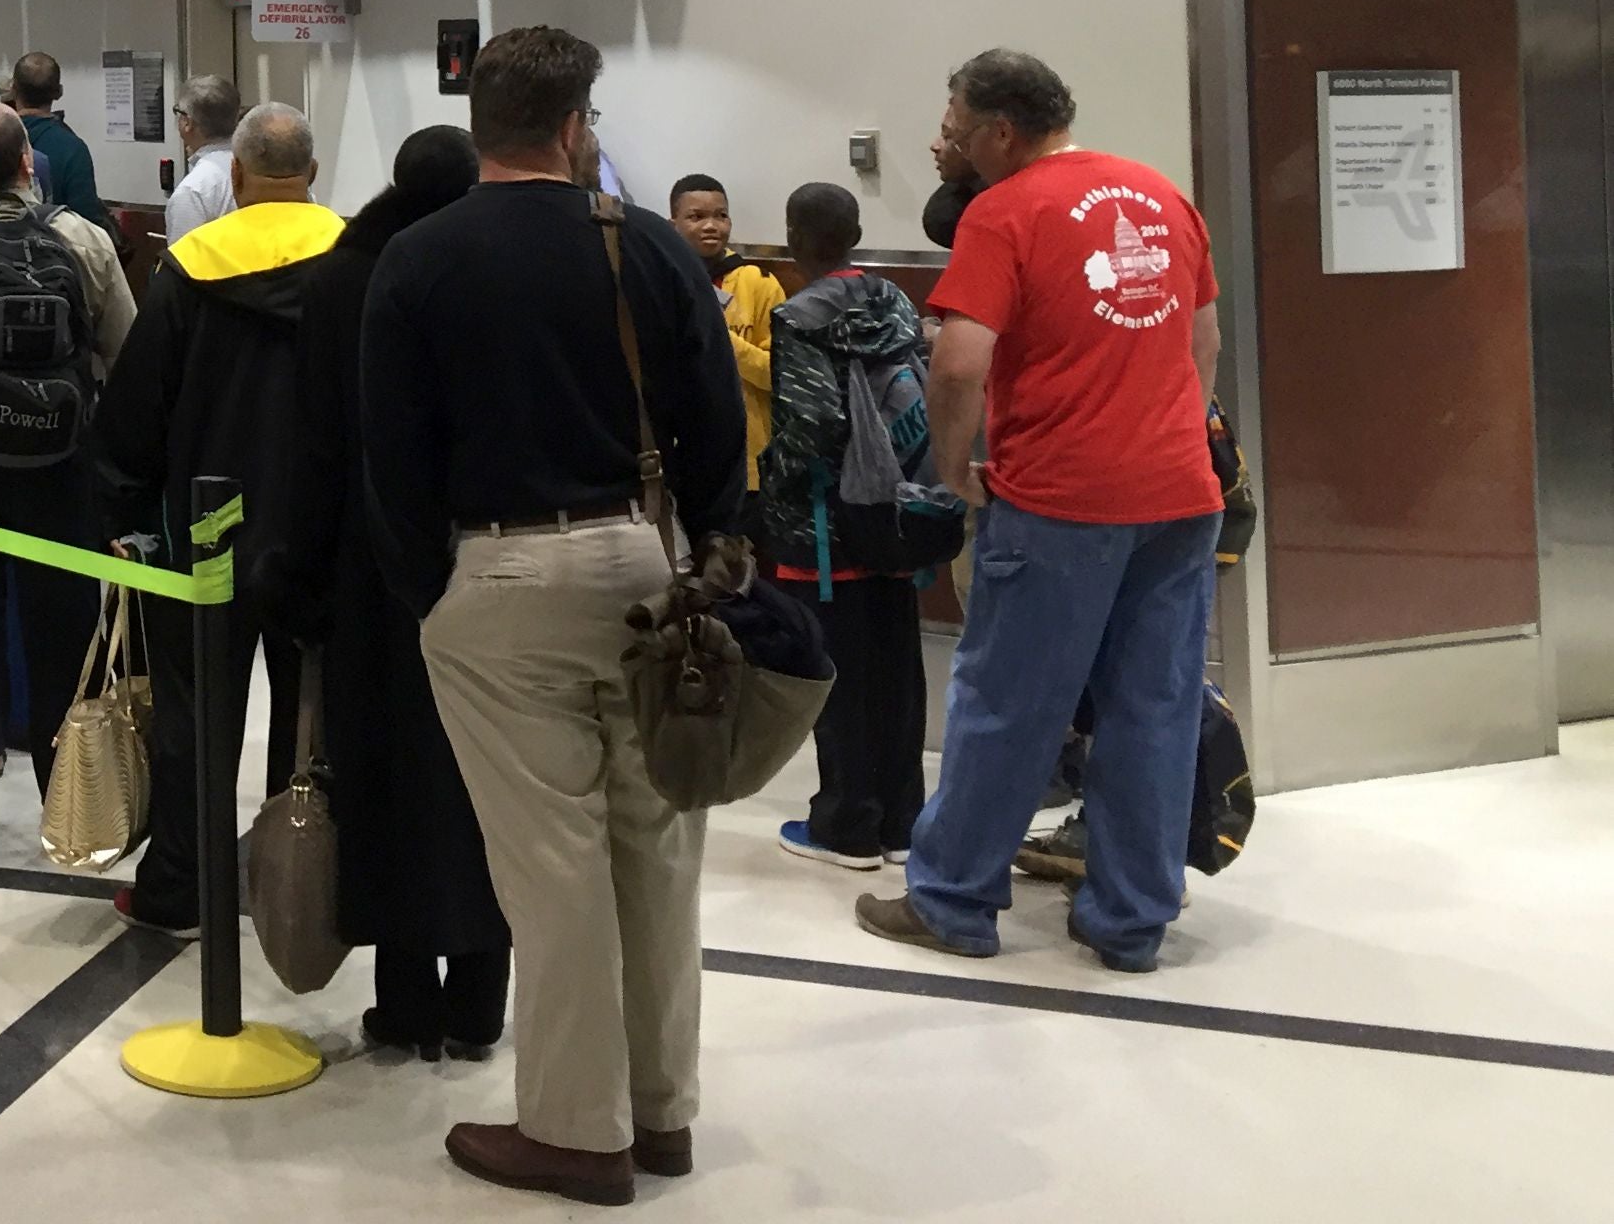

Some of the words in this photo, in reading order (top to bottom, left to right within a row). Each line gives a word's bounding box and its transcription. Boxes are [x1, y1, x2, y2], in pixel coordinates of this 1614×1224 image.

[266, 3, 339, 13] EMERGENCY
[258, 14, 346, 25] DEFIBRILLATOR
[294, 27, 311, 39] 26
[1069, 185, 1163, 222] Bethlehem
[1093, 294, 1180, 329] Elementary
